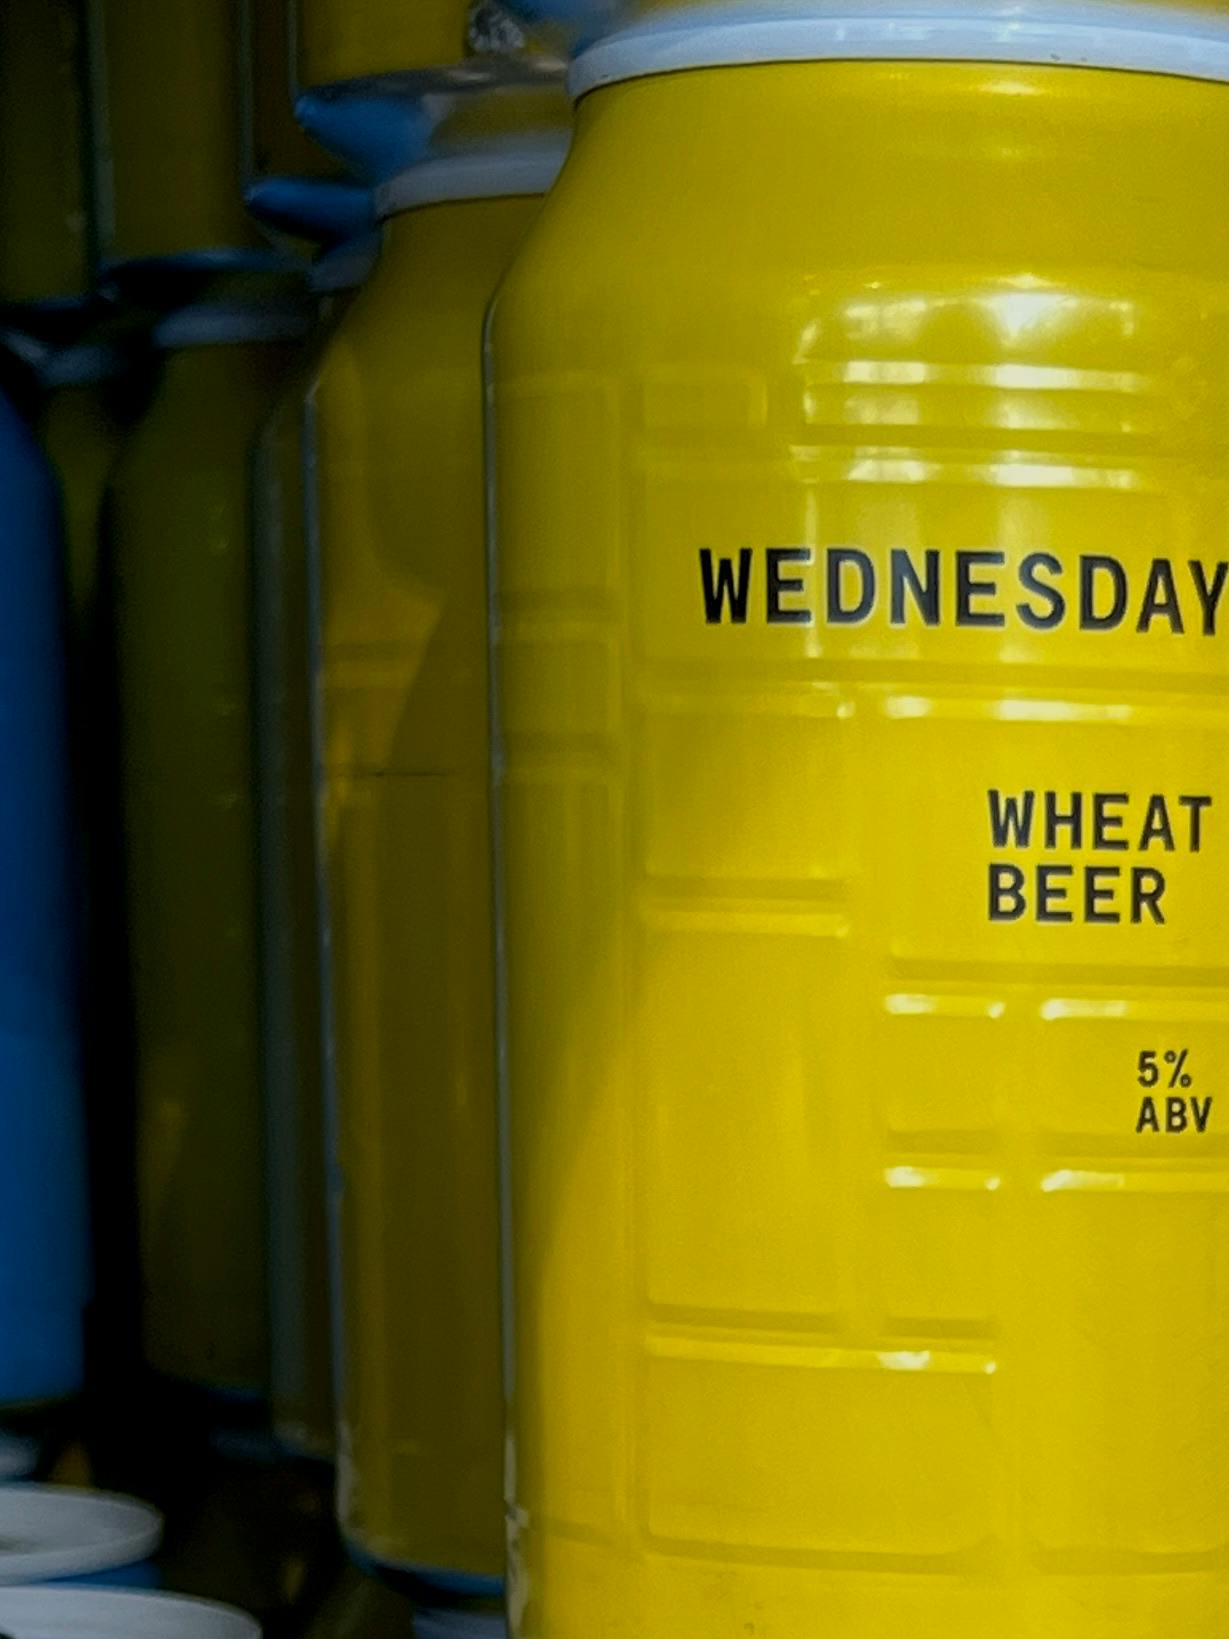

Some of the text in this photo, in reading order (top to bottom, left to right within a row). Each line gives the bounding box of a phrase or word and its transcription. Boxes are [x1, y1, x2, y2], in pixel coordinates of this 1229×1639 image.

[698, 546, 1229, 636] WEDNESDAY
[987, 789, 1213, 853] WHEAT
[988, 863, 1167, 925] BEER
[1136, 1048, 1193, 1089] 5%
[1135, 1096, 1213, 1134] ABV
